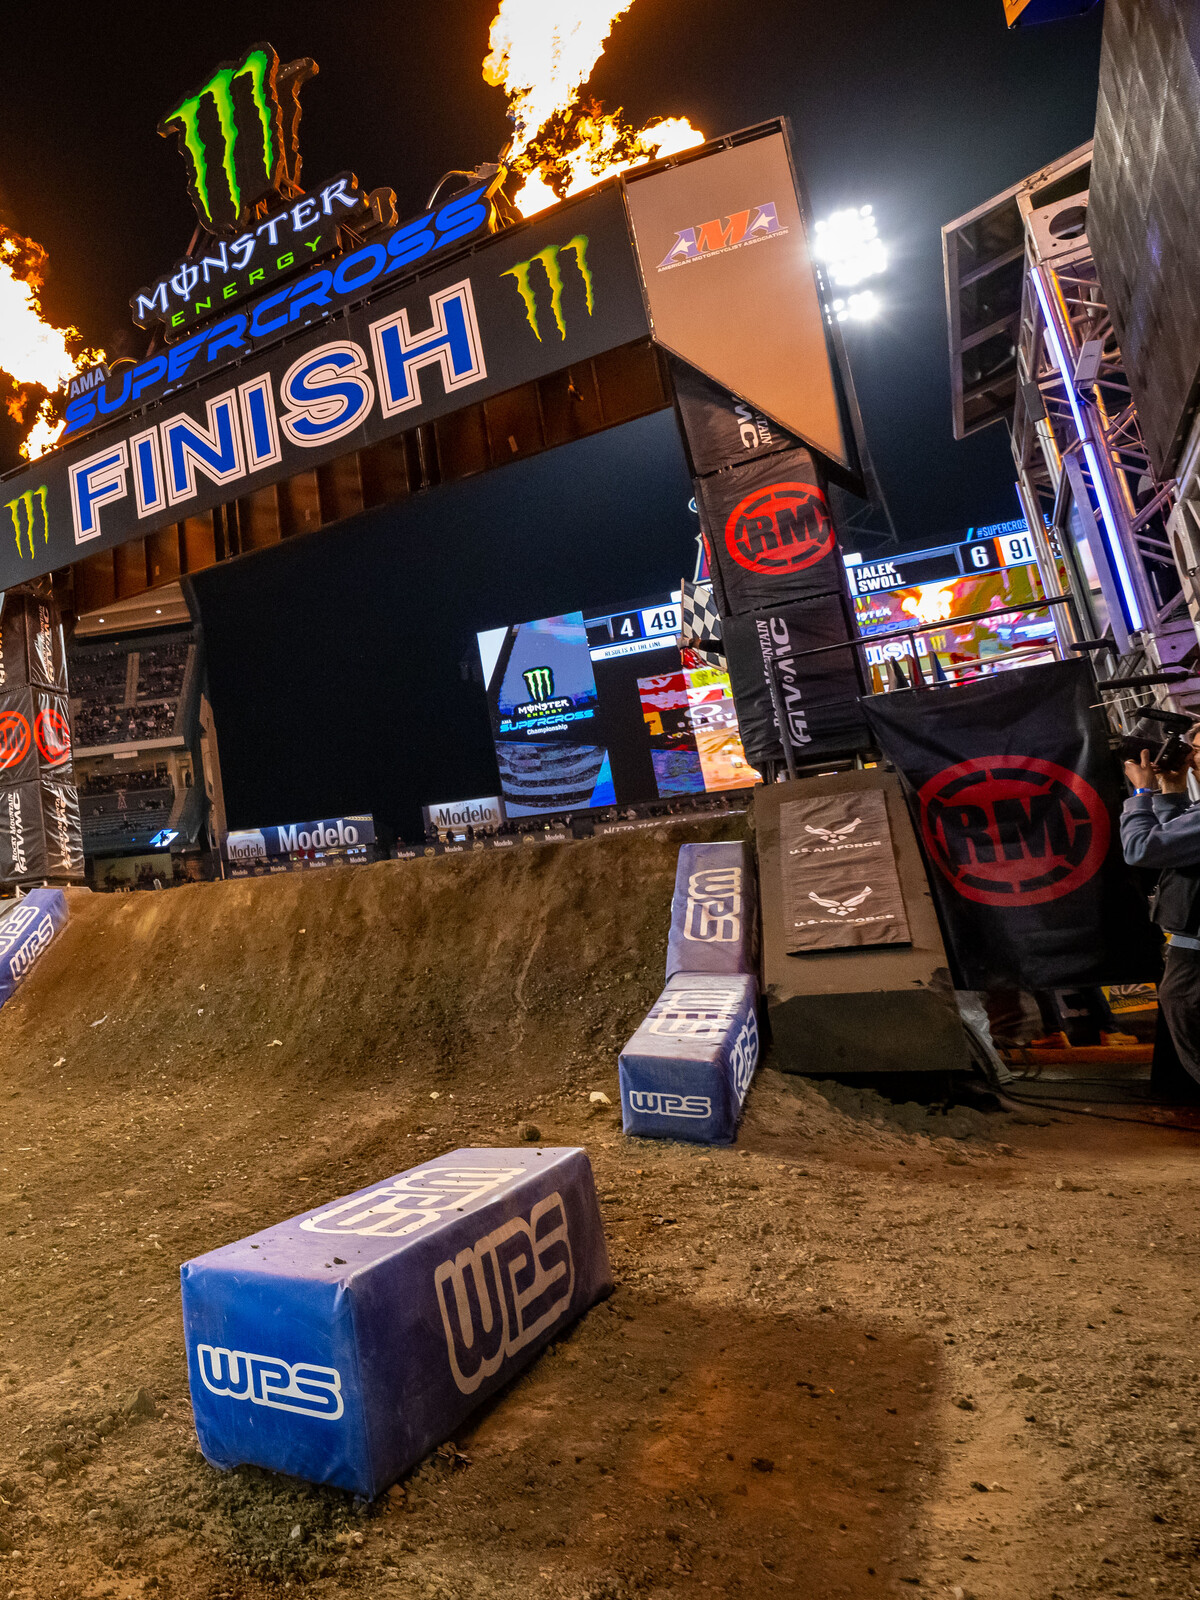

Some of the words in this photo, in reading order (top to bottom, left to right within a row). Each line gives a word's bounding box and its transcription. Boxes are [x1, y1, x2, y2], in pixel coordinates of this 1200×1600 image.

[656, 201, 789, 268] AMA
[135, 178, 358, 319] MONSTER
[657, 258, 691, 273] AMERICAN
[692, 243, 742, 263] MOTORCYCLIST
[743, 229, 789, 247] ASSOCIATION
[171, 235, 323, 328] ENERGY
[63, 184, 487, 436] SUPERCROSS
[70, 367, 105, 398] AMA
[68, 278, 487, 545] FINISH
[970, 546, 990, 567] 6
[1009, 536, 1032, 560] 91
[857, 562, 896, 580] JALEK
[859, 573, 906, 592] SWOLL
[620, 618, 634, 637] 4
[651, 610, 677, 631] 49
[637, 643, 648, 651] THE
[648, 641, 661, 650] LINE
[518, 699, 570, 714] MONSTER
[500, 709, 594, 733] SUPERCROSS
[527, 724, 568, 735] Championship
[7, 793, 17, 835] MOUNTAIN
[439, 804, 492, 826] Modelo
[277, 819, 359, 853] Modelo
[940, 794, 1068, 866] RM
[11, 836, 19, 861] ROCKY
[230, 843, 264, 859] Modelo
[789, 847, 812, 855] U.S.
[837, 840, 882, 851] FORCE
[684, 867, 742, 942] WPS
[846, 914, 895, 923] FORCE
[10, 914, 54, 981] WPS
[629, 1090, 712, 1118] WPS
[434, 1191, 575, 1395] WPS
[197, 1343, 344, 1421] WPS
